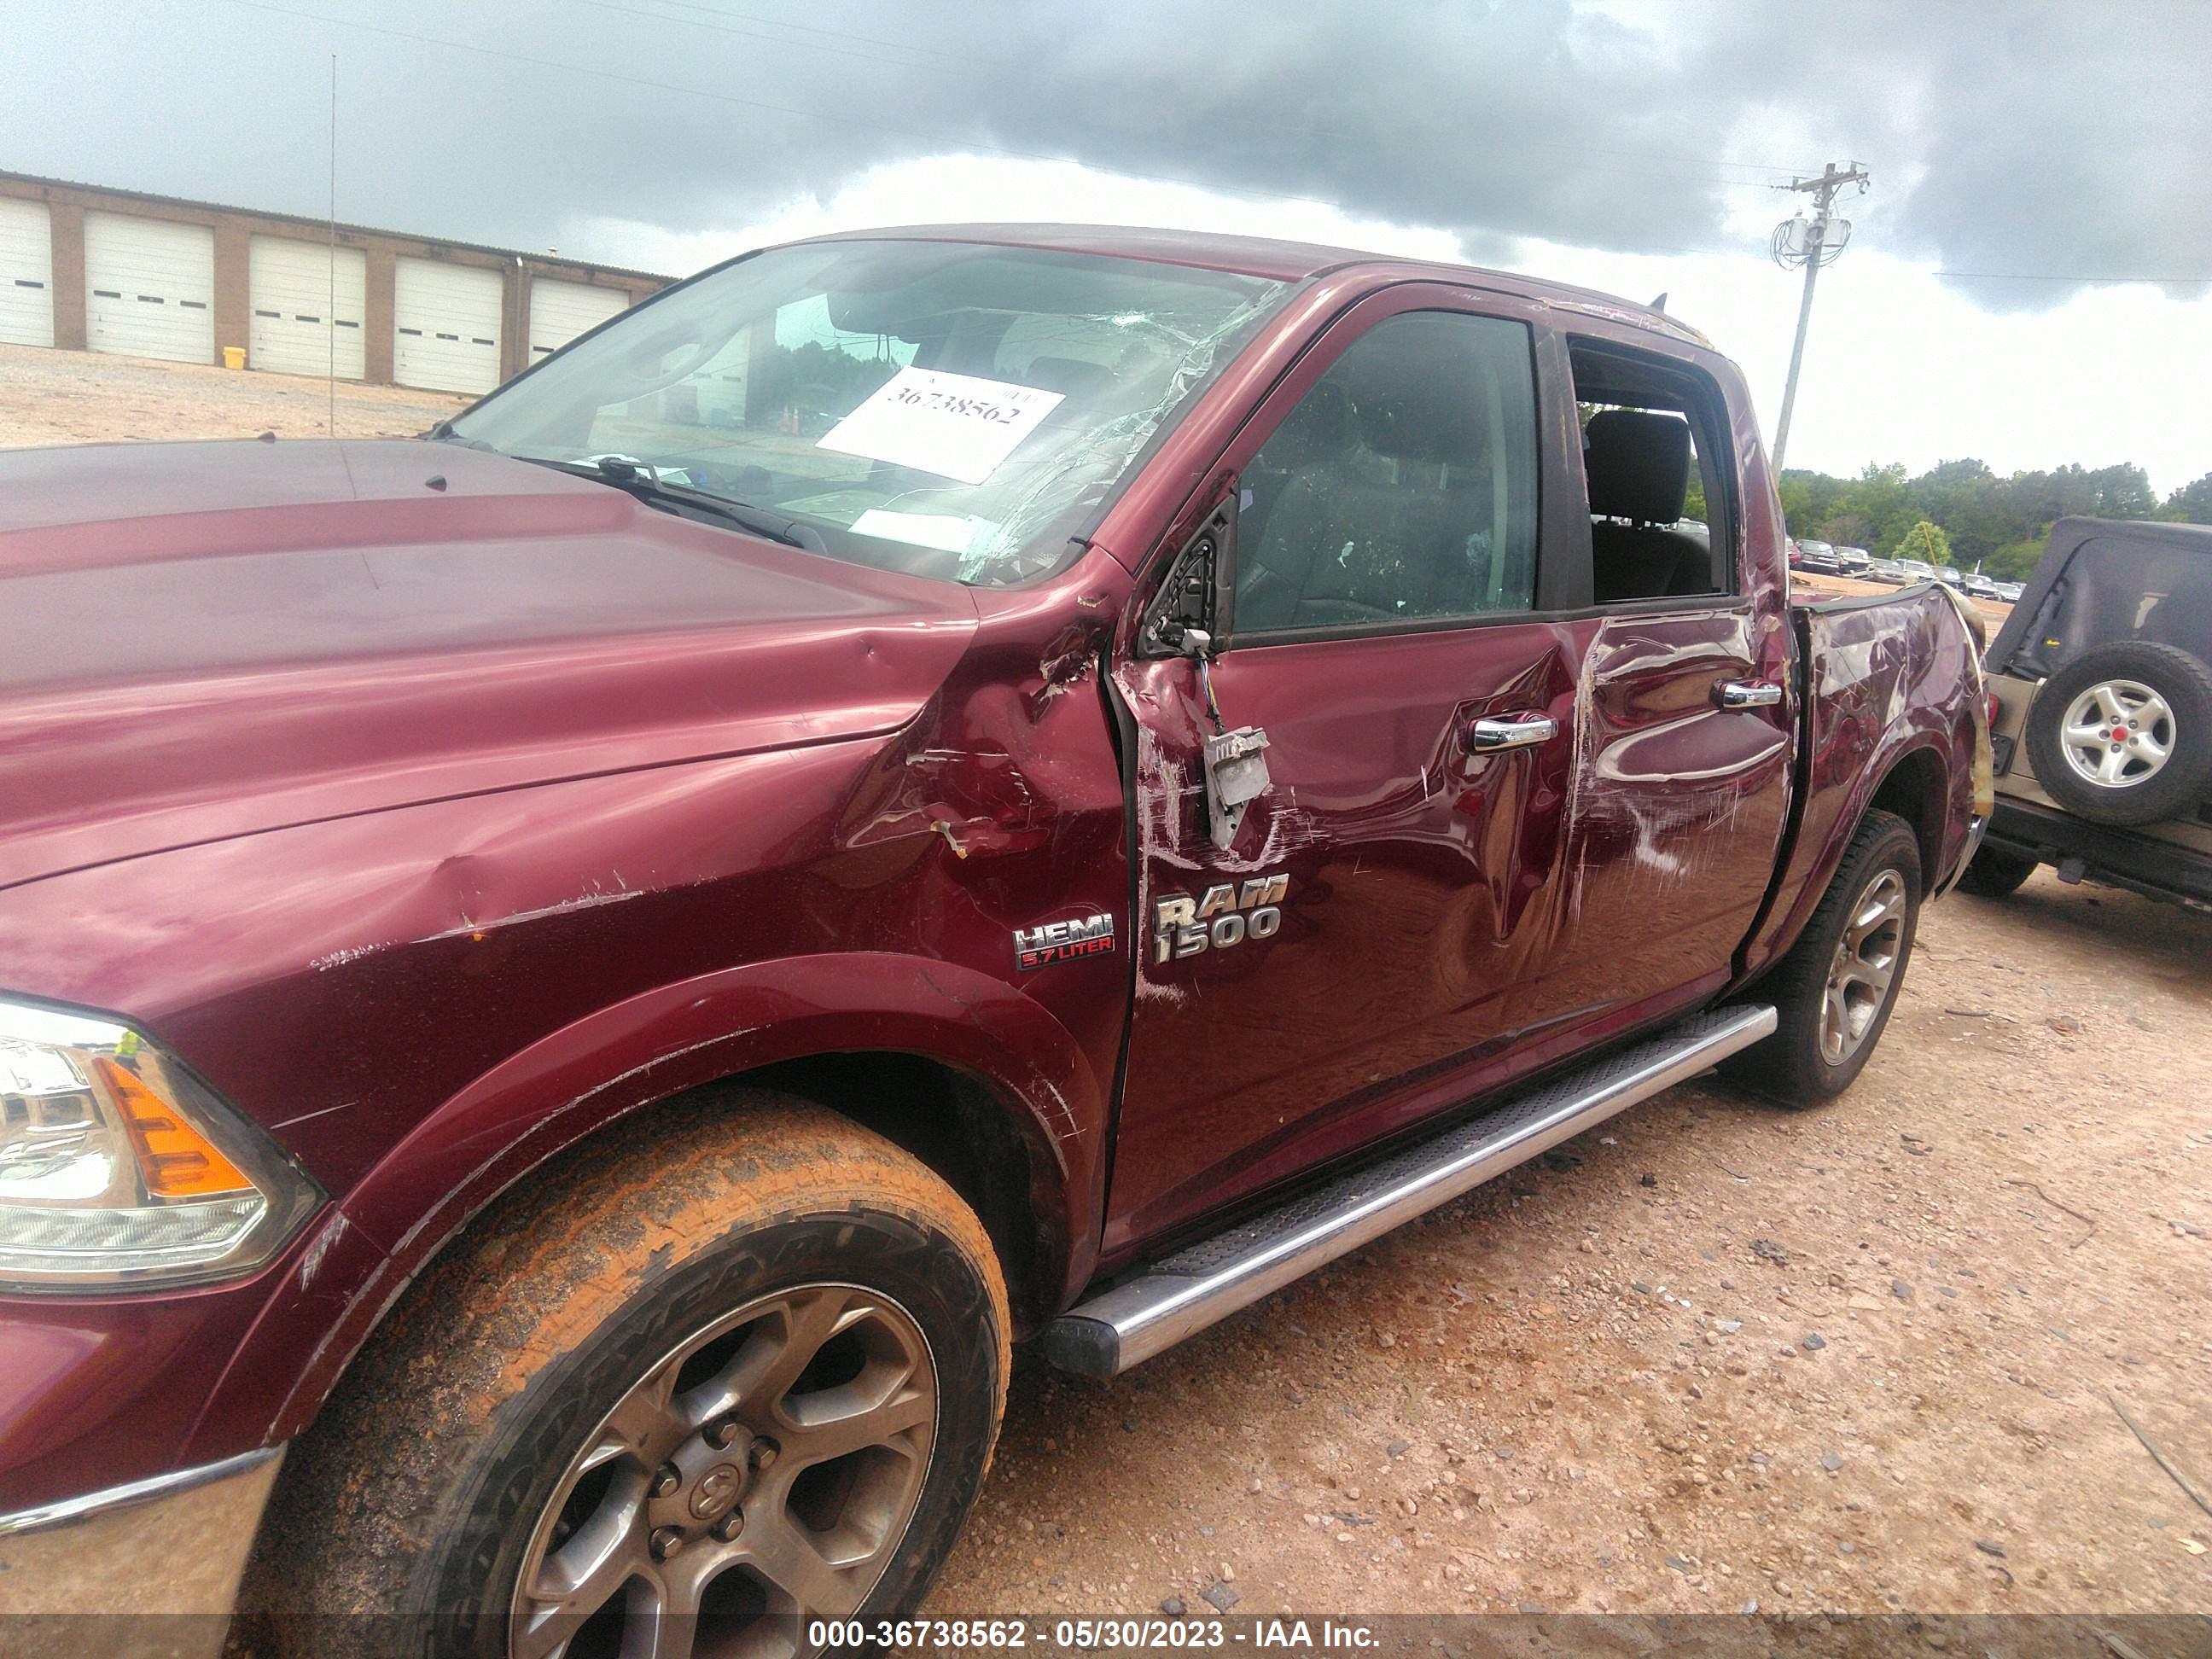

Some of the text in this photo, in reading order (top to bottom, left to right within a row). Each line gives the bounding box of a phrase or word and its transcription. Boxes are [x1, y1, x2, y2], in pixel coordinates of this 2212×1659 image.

[888, 387, 1021, 424] 36738562
[1155, 872, 1289, 934] RAM
[1013, 912, 1114, 953] HEMI
[1022, 936, 1112, 968] 5.7 LITER
[1154, 906, 1281, 965] 1500
